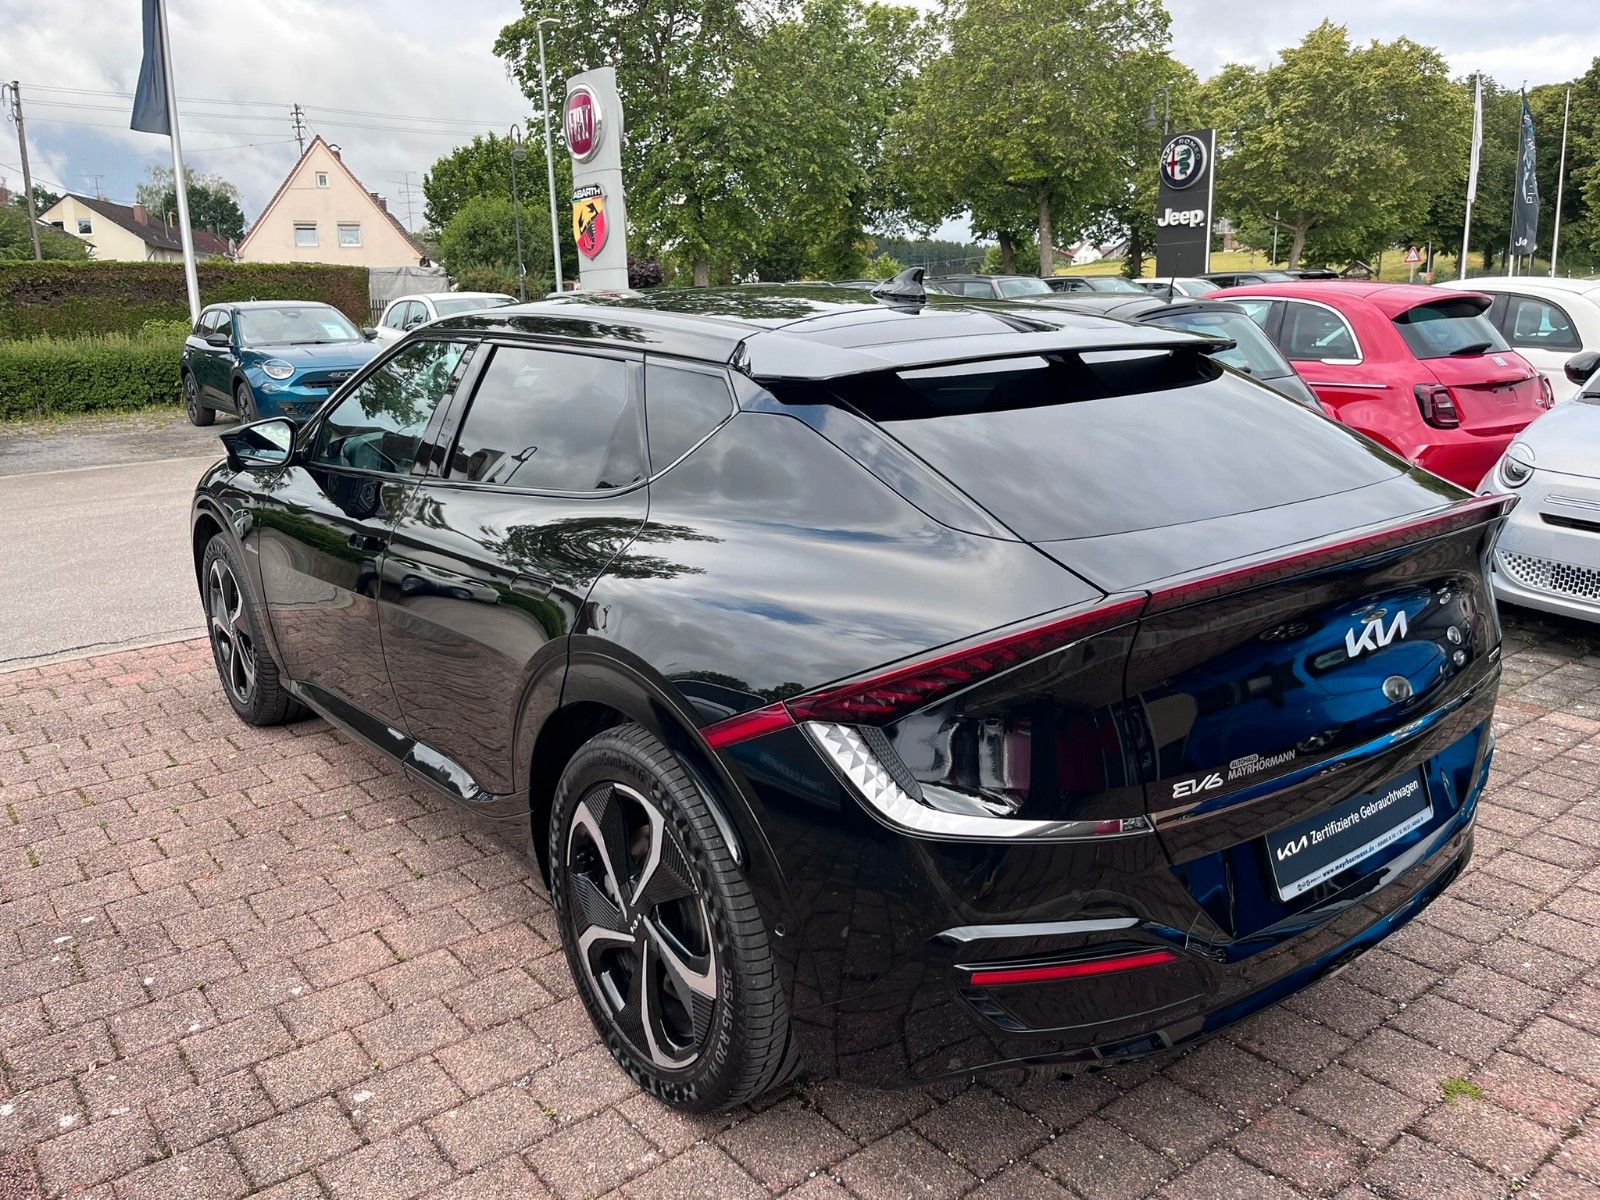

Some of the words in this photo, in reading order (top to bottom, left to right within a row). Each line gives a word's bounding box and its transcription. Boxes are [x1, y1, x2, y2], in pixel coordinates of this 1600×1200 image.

[568, 105, 591, 142] FIAT
[1162, 143, 1176, 166] ALFA
[1178, 138, 1201, 160] ROMEO
[573, 186, 601, 199] ABARTH
[1345, 610, 1408, 658] KIA
[1228, 749, 1296, 781] MAYRHÖRMANN
[1172, 772, 1224, 799] EV6
[1276, 834, 1309, 861] KIA
[1309, 812, 1360, 845] Zertifizierte
[1359, 779, 1419, 819] Gebrauchtwagen
[721, 965, 734, 1030] 255/45
